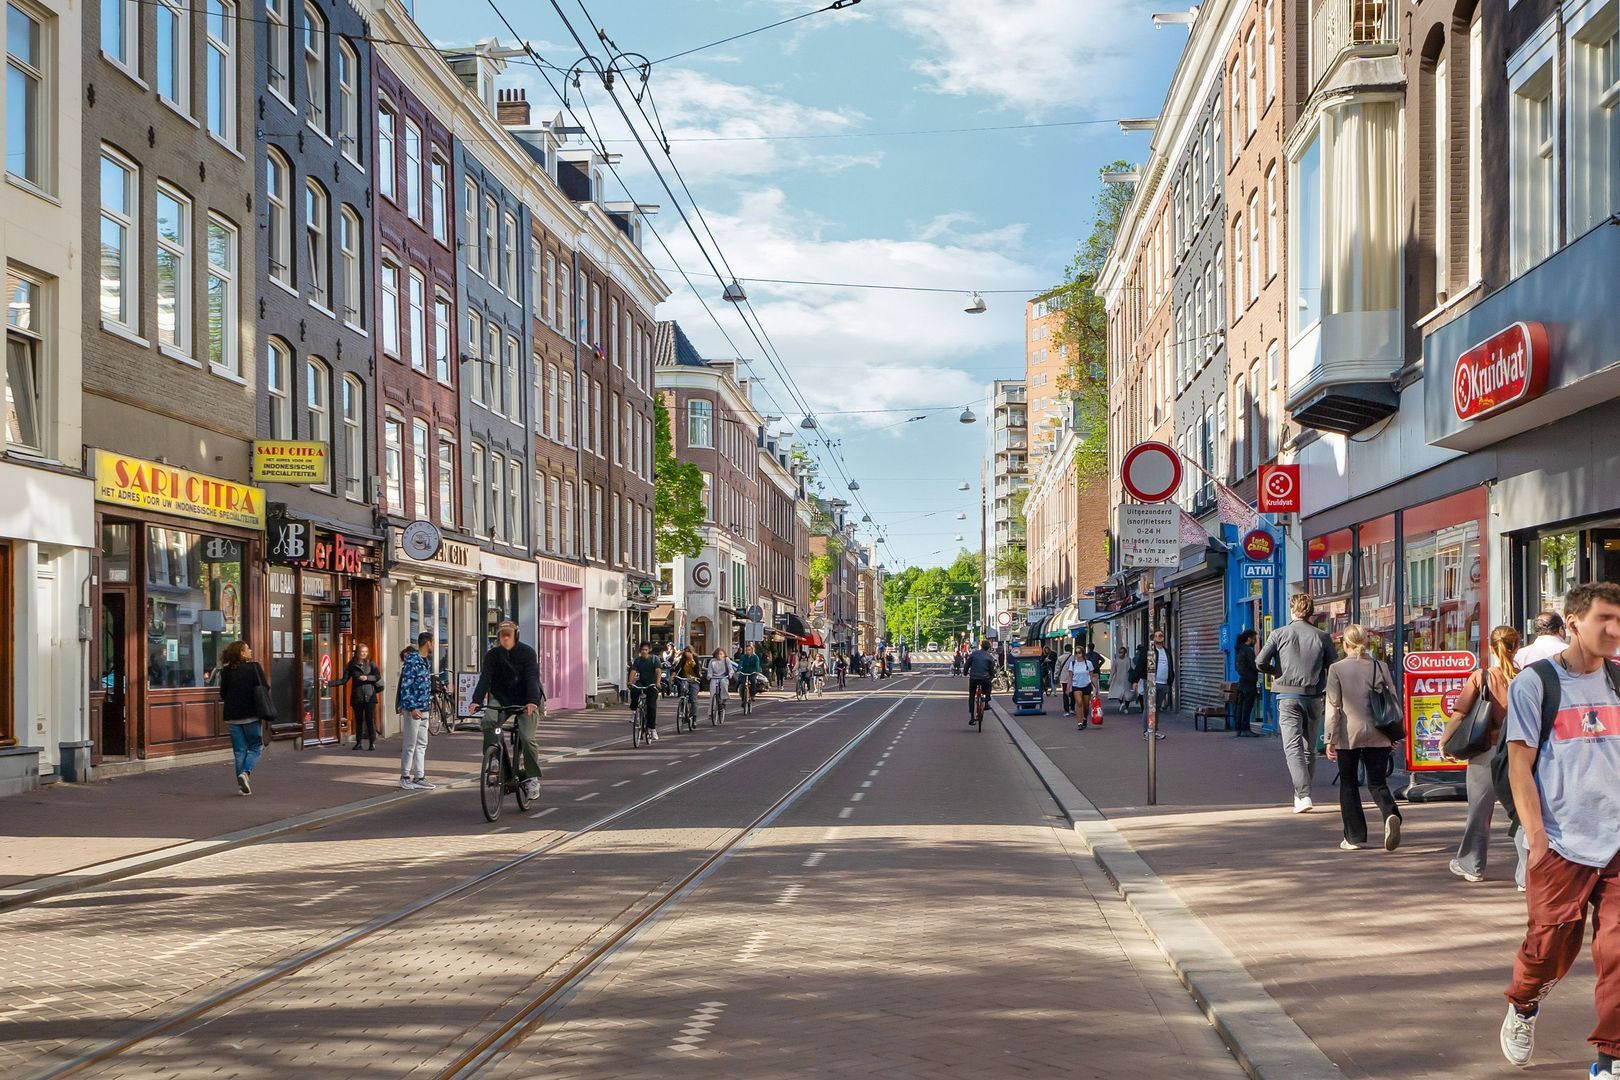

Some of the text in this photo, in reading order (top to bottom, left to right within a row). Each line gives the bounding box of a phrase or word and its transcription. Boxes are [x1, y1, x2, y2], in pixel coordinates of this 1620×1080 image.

[1471, 341, 1524, 400] Kruidvat
[257, 446, 324, 457] SARI CITRA
[115, 459, 256, 515] SARI CITRA
[101, 487, 259, 525] HET ADRES VOOR UW INDONESISCHE SPECIALITEITEN
[1266, 498, 1293, 507] Kruidvat
[335, 533, 361, 573] Bas
[450, 544, 470, 566] CITY
[1246, 566, 1272, 575] ATM
[1422, 655, 1470, 668] Kruidvat
